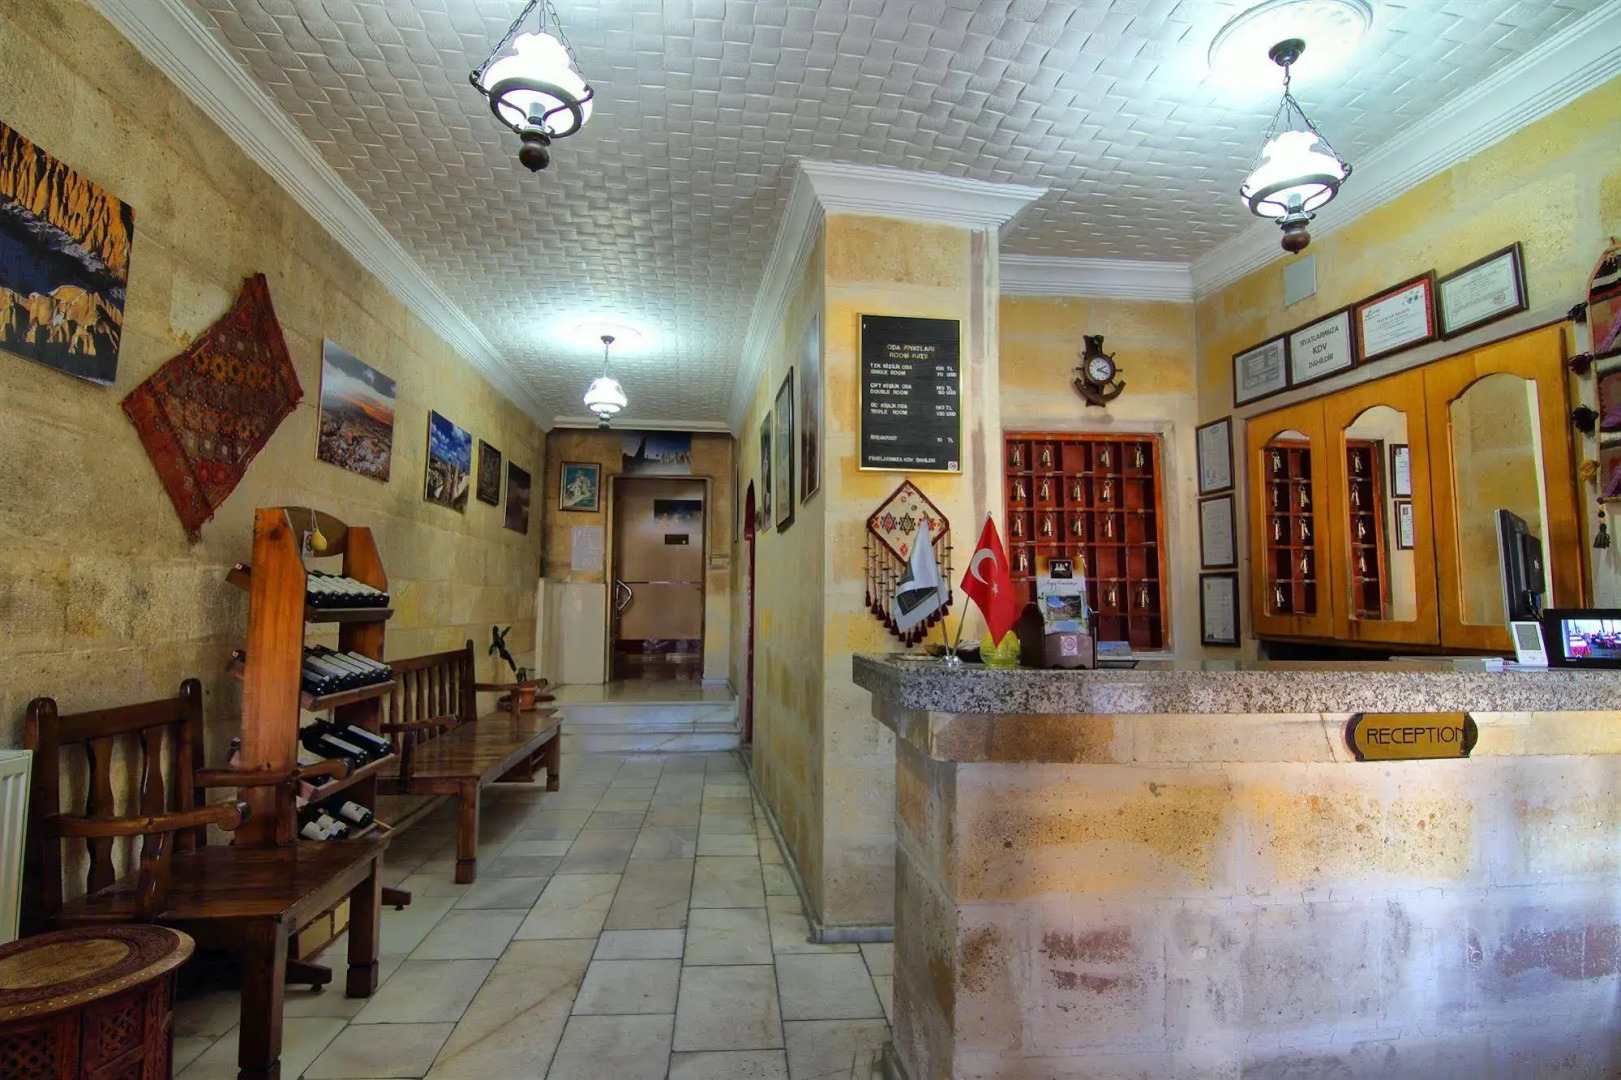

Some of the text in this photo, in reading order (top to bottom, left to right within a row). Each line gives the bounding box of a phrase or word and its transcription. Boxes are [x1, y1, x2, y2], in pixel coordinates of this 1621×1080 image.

[1300, 326, 1339, 346] FİYATLARIMIZA
[1312, 342, 1328, 354] KDV
[1308, 353, 1334, 369] DAHİLDİR
[1367, 726, 1465, 744] RECEPTION
